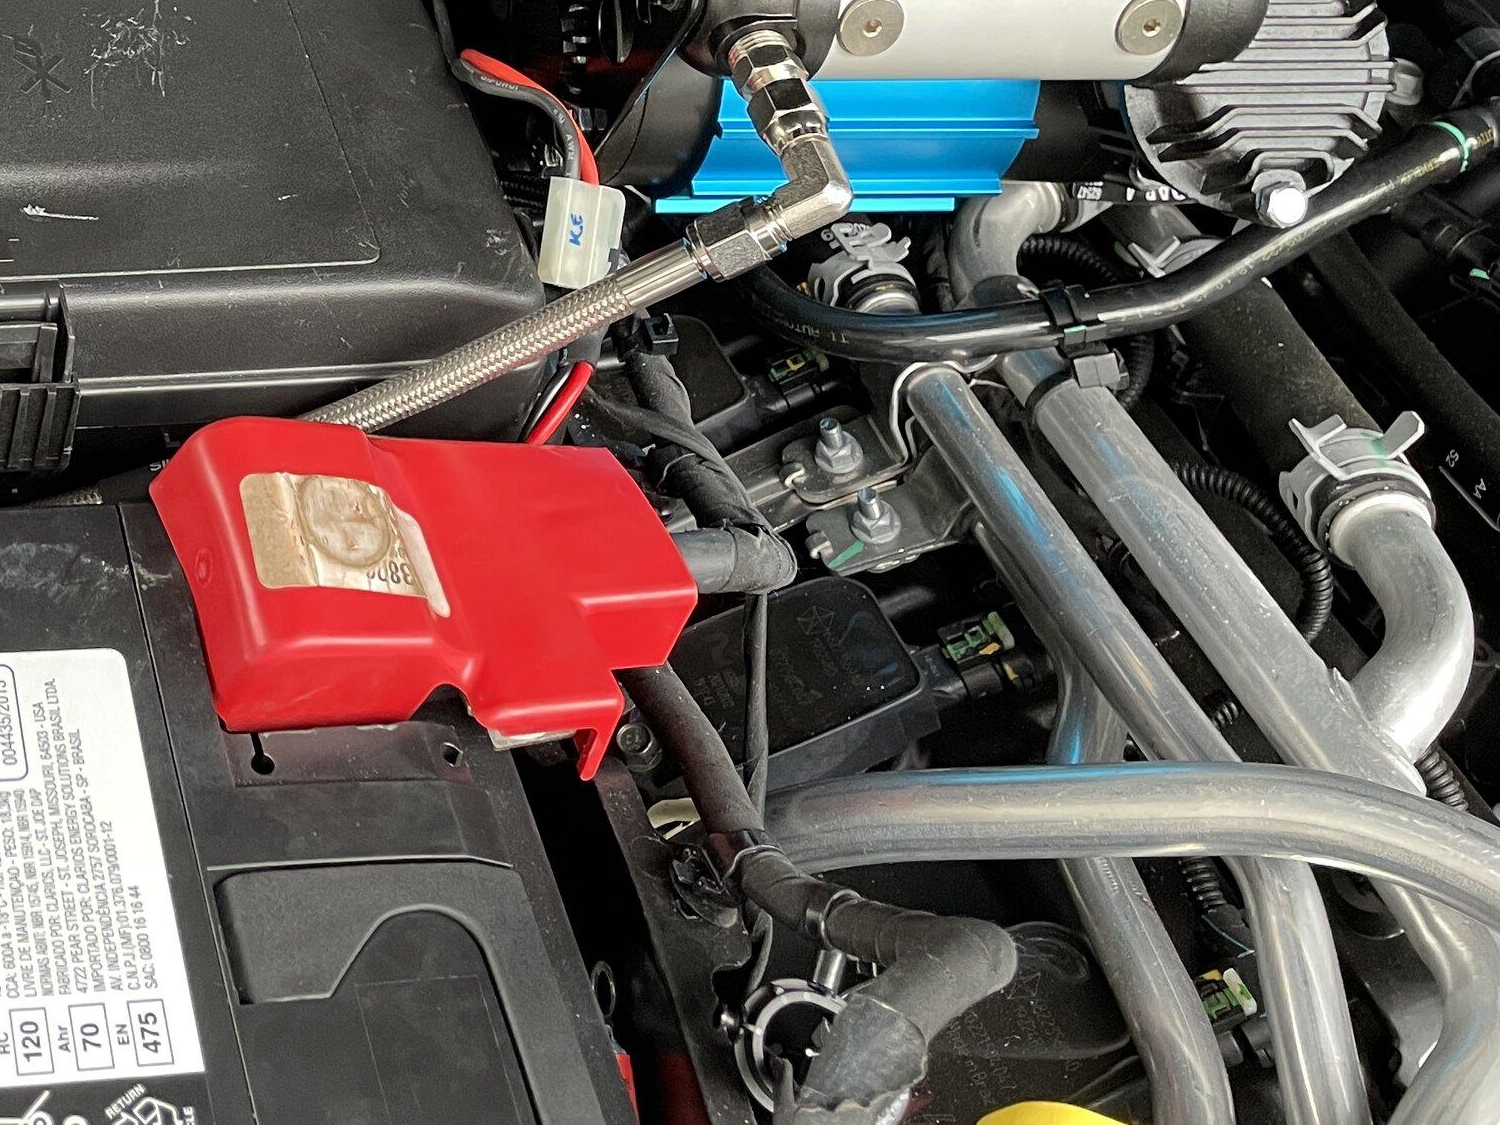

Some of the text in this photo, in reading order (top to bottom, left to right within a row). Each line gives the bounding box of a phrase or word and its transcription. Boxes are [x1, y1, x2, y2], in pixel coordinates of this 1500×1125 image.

[31, 701, 46, 722] USA
[47, 705, 65, 741] BRASIL
[67, 728, 85, 765] BRASIL
[53, 743, 75, 800] SOLUTIONS
[74, 772, 89, 787] SP
[63, 802, 82, 844] ENERGY
[78, 795, 100, 853] SOROCABA
[70, 846, 90, 893] CLARIOS
[60, 889, 79, 931] STREET
[90, 882, 120, 971] INDEPENDÊNCIA
[17, 946, 32, 961] DE
[67, 933, 84, 963] PEAR
[82, 924, 106, 992] IMPORTADO
[19, 963, 37, 997] LIVRE
[72, 965, 89, 994] 4722
[18, 1019, 43, 1062] 120
[55, 1024, 71, 1053] Ahr
[78, 1022, 102, 1052] 70
[114, 1023, 130, 1045] EN
[136, 1011, 163, 1054] 475
[103, 1082, 148, 1121] RETURN
